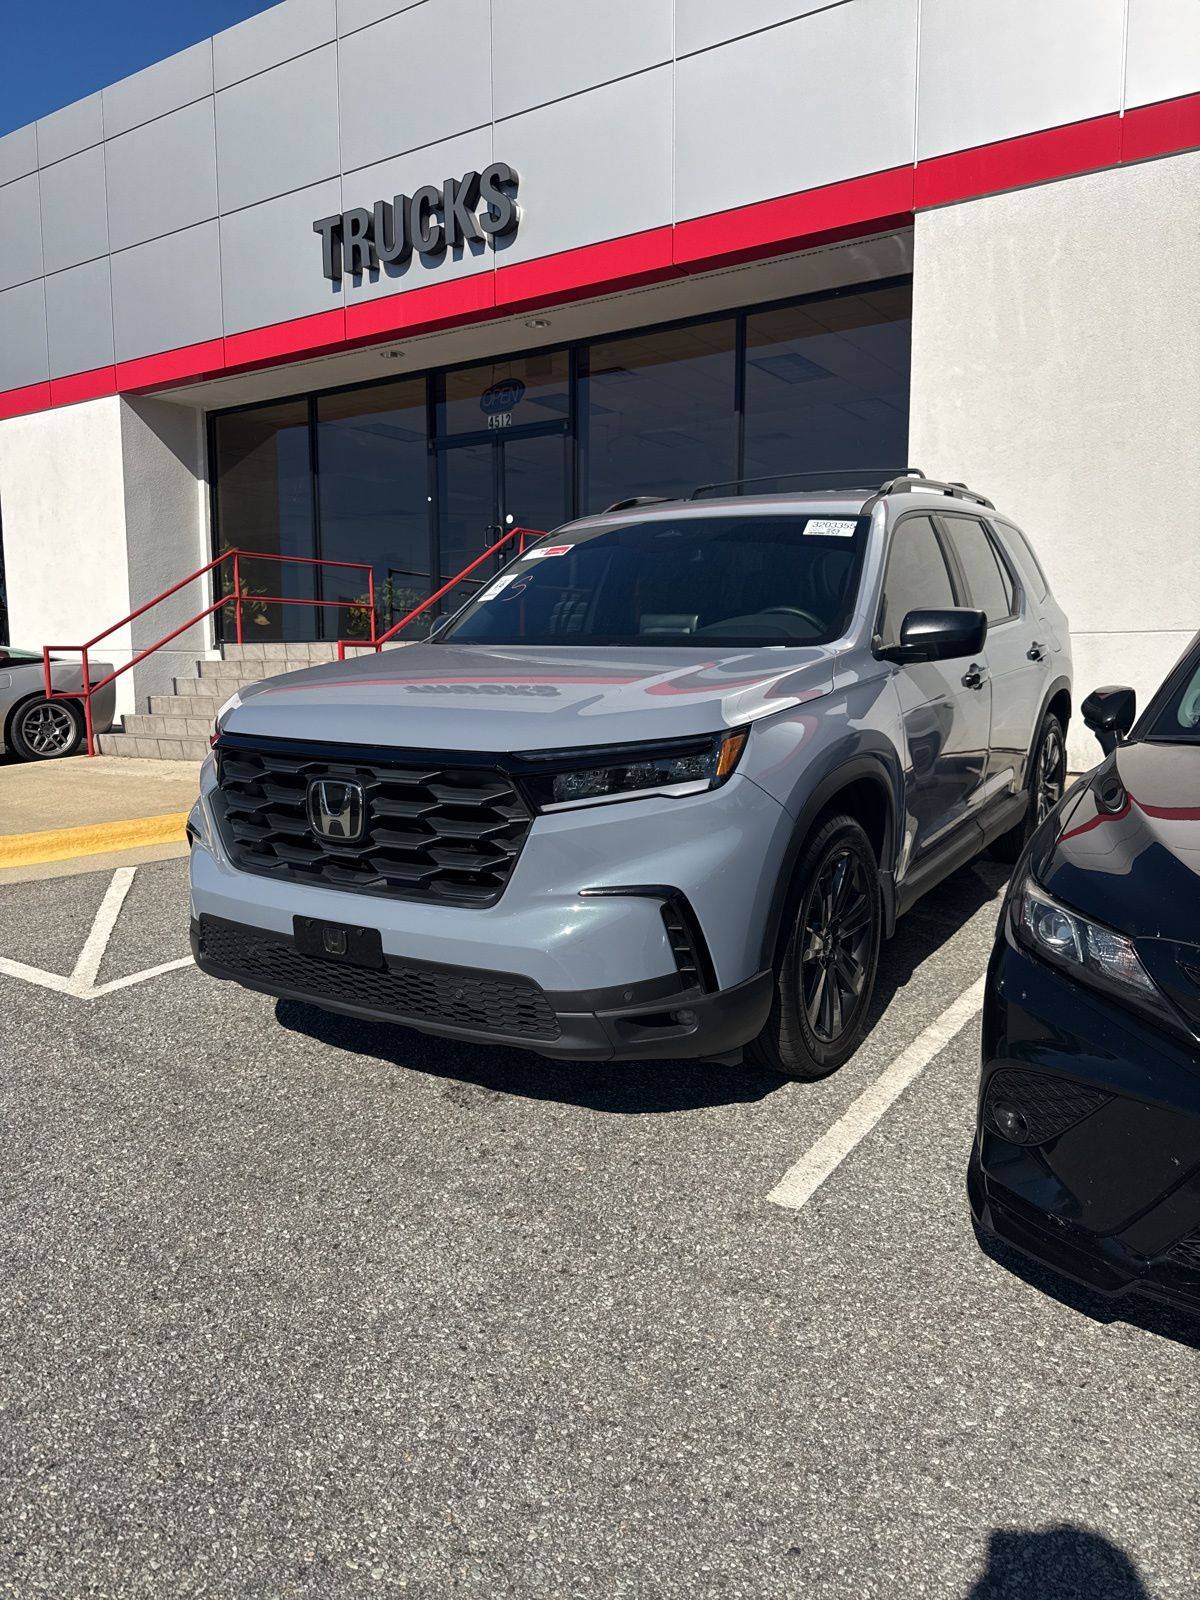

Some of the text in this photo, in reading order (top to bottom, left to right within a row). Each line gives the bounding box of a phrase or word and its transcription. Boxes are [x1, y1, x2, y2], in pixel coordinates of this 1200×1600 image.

[312, 162, 520, 281] TRUCKS
[483, 383, 520, 408] OPEN
[488, 413, 512, 429] 4512
